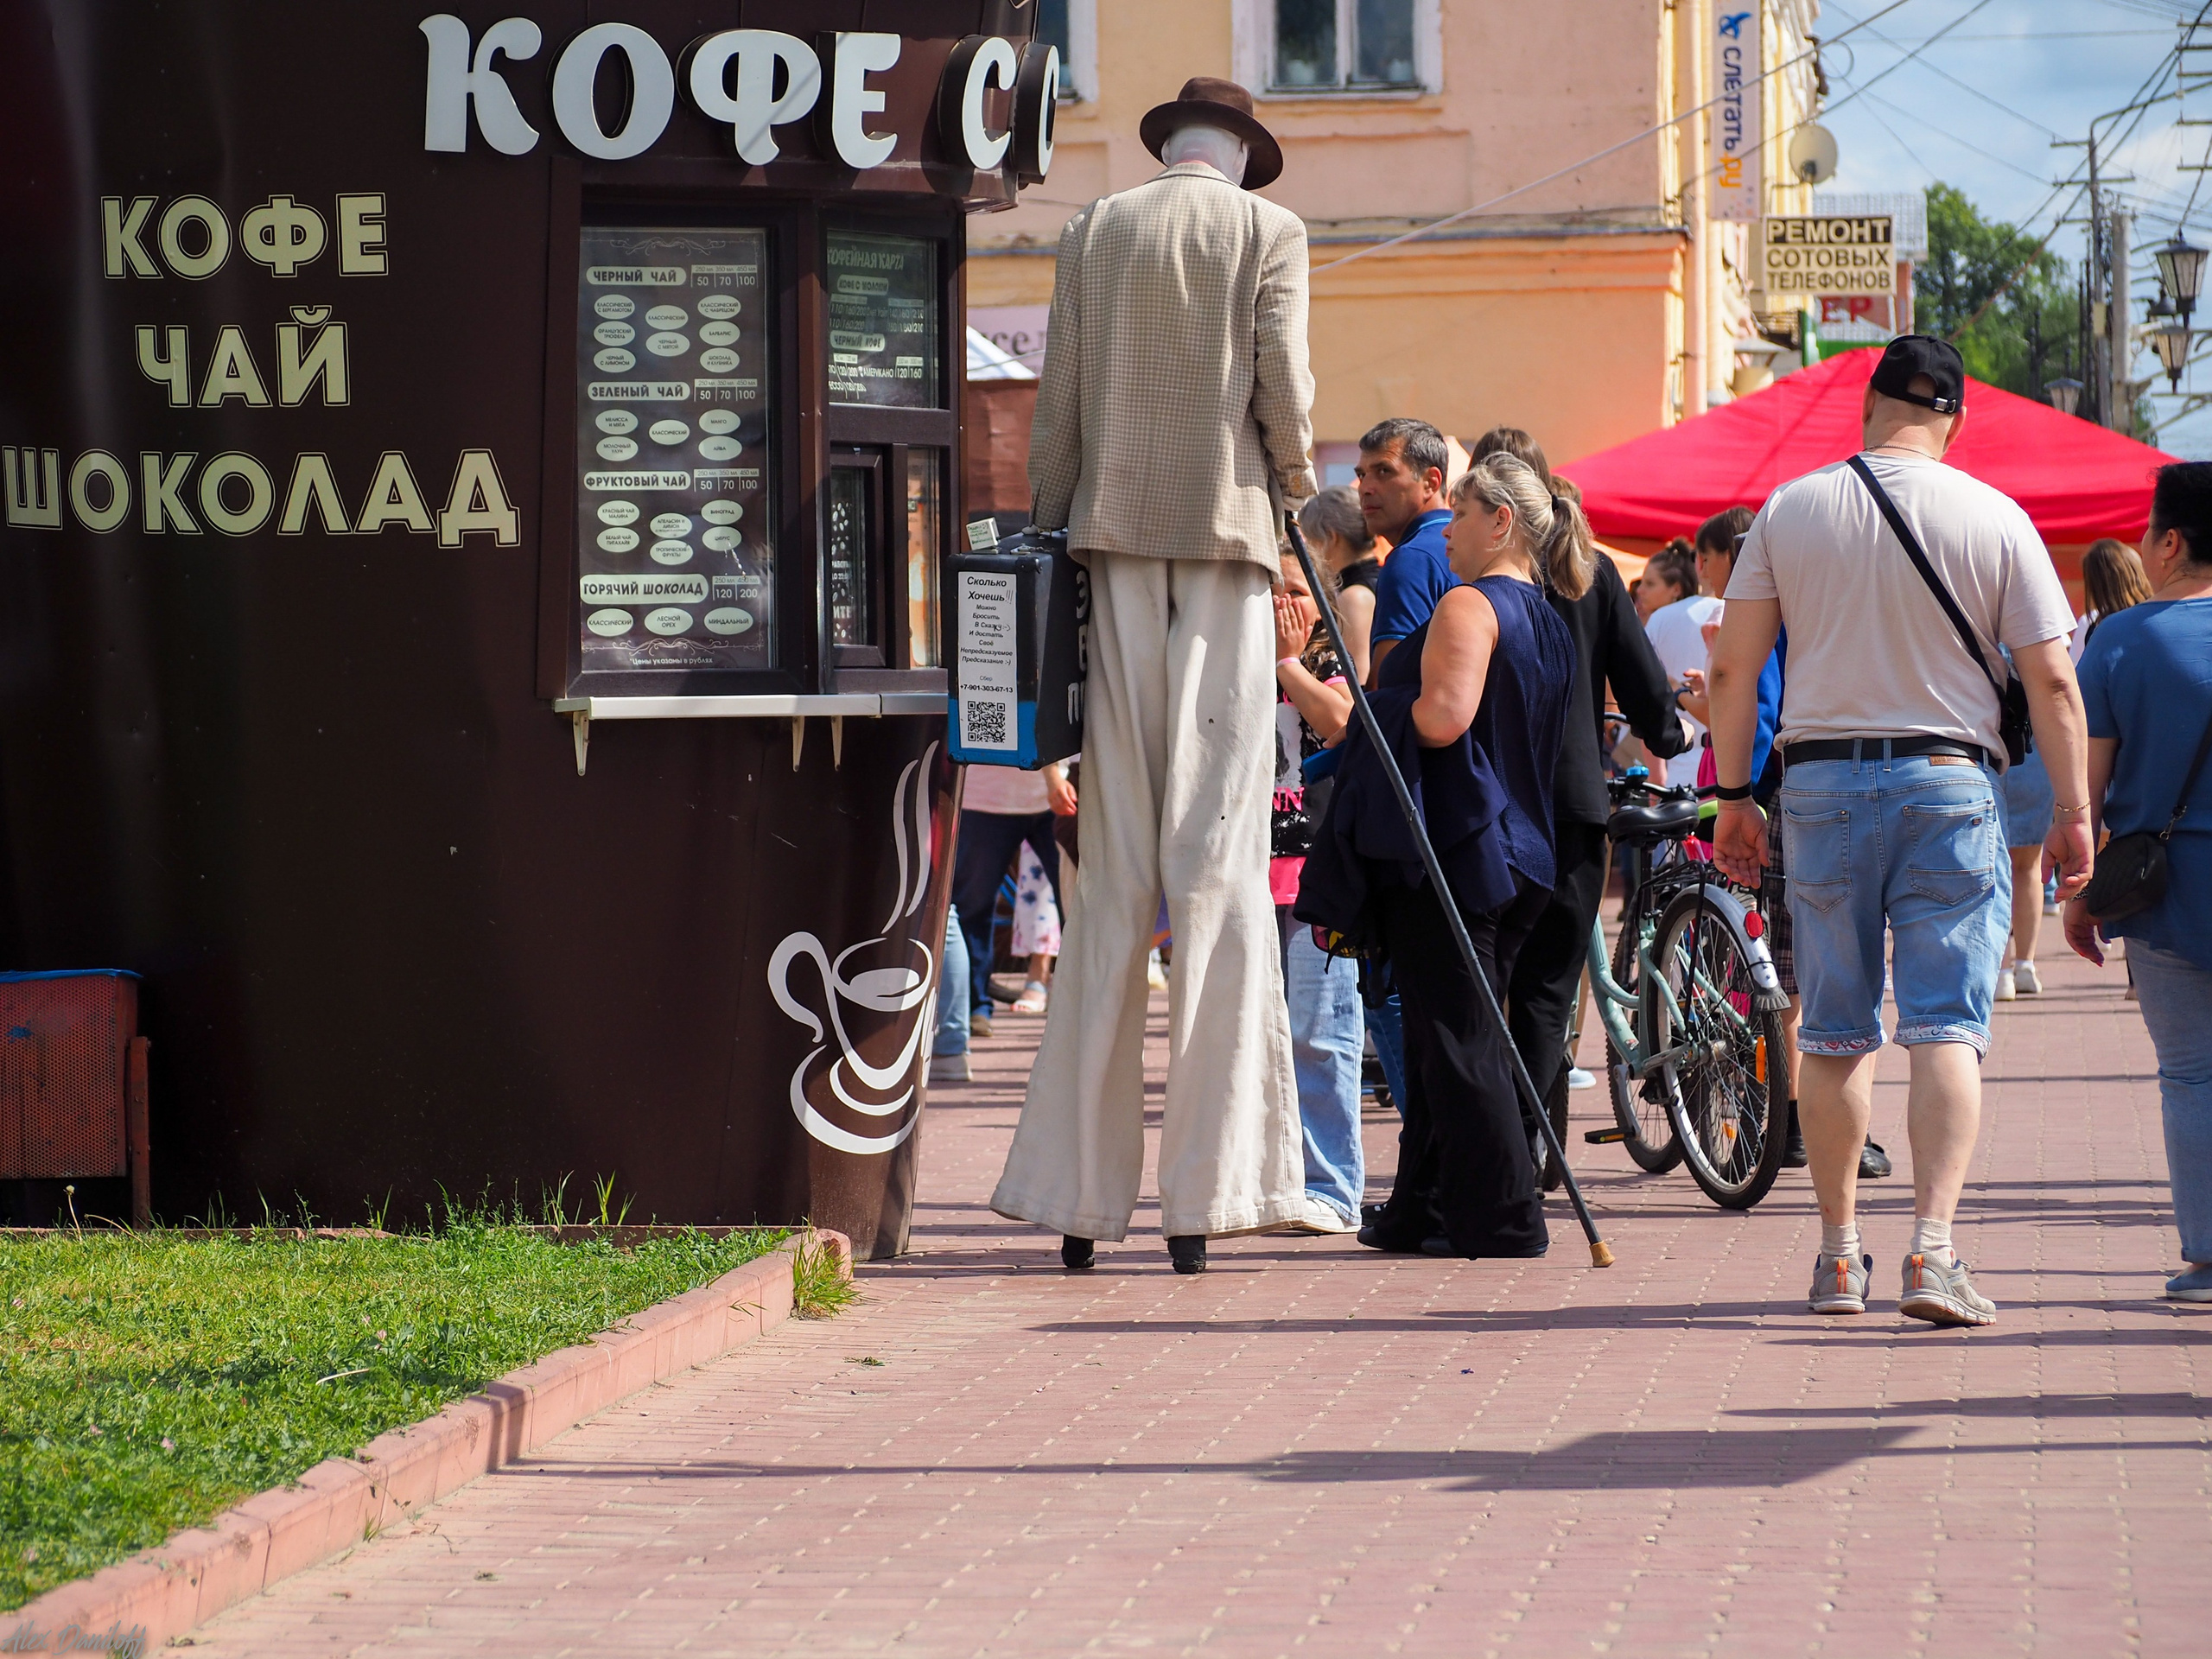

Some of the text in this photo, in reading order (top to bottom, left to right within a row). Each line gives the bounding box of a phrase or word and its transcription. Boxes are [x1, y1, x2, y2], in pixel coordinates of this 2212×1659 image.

[418, 14, 900, 168] КОФЕ
[101, 193, 389, 280] КОФЕ
[1768, 219, 1890, 243] РЕМОНТ
[1768, 248, 1889, 268] СОТОВЫХ
[594, 270, 677, 282] ЧЕРНЫЙ ЧАЙ
[697, 276, 755, 286] 50 70 100
[1767, 270, 1890, 289] ТЕЛЕФОНОВ
[135, 305, 352, 407] ЧАЙ
[864, 368, 893, 378] АМЕРИКАНО
[897, 368, 907, 378] 120
[911, 368, 922, 378] 160
[592, 385, 683, 397] ЗЕЛЕНЫЙ ЧАЙ
[700, 391, 755, 399] 50 70 100
[587, 474, 686, 486] ФРУКТОВЫЙ ЧАЙ
[700, 480, 757, 489] 50 70 100
[3, 446, 521, 548] ШОКОЛАД
[967, 576, 1007, 587] Сколько
[584, 582, 703, 595] ГОРЯЧИЙ ШОКОЛАД
[715, 588, 757, 598] 120 200
[961, 647, 1013, 656] Непредсказуемое
[961, 684, 1013, 693] +7-901-303-67-13
